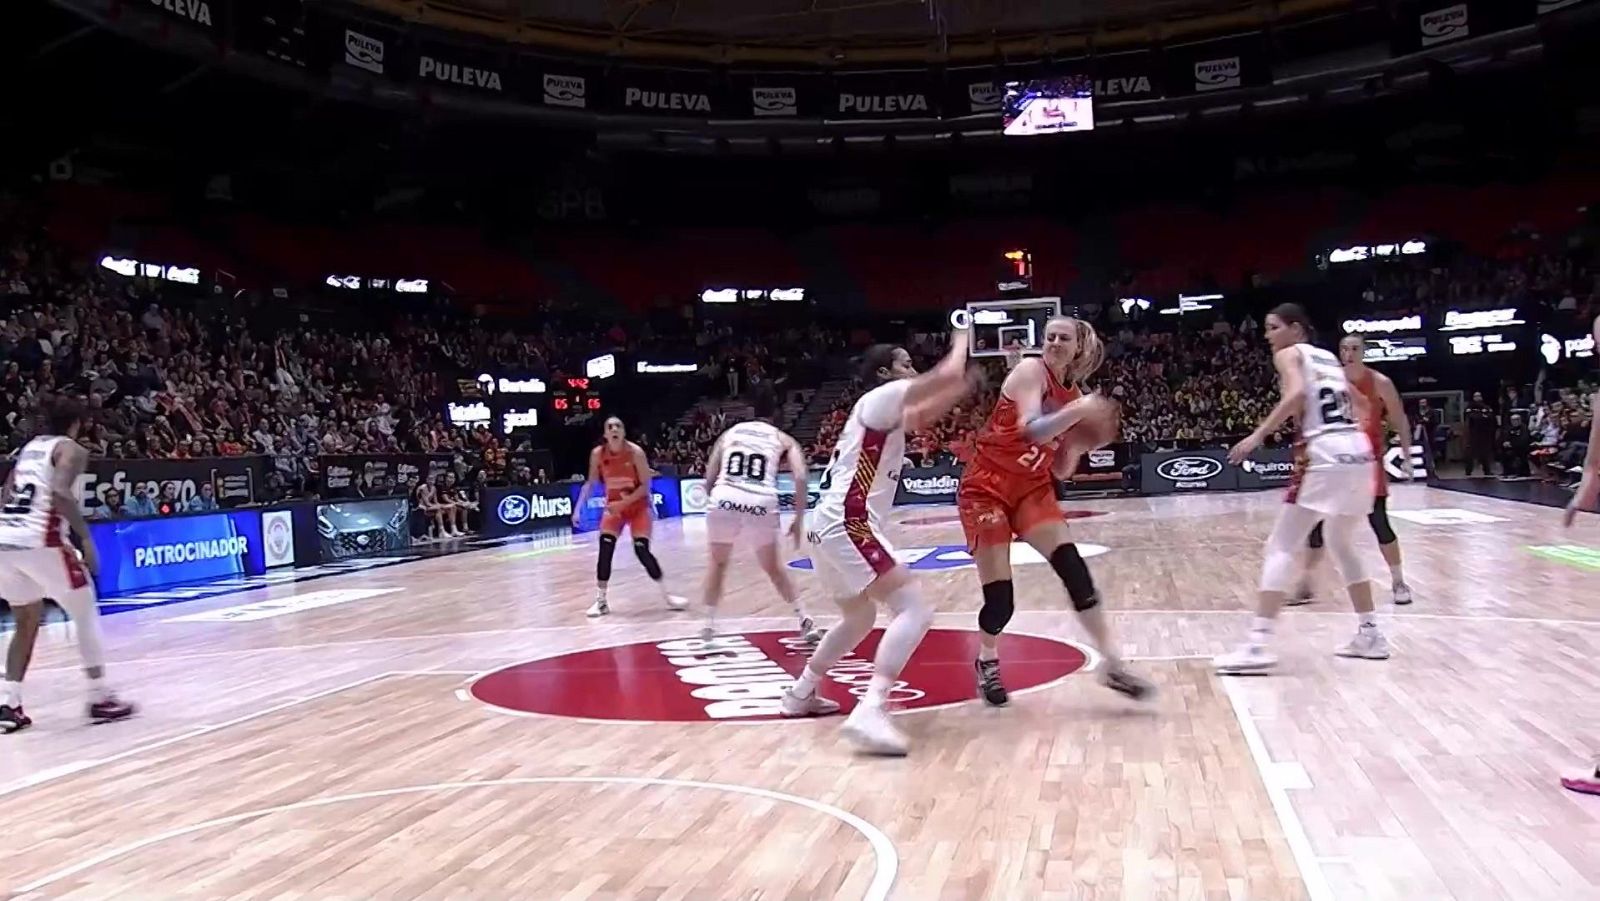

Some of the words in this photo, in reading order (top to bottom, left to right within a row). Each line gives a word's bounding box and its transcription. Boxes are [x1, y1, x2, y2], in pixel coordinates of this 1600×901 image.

[418, 56, 502, 91] PULEVA
[1094, 76, 1151, 96] LEVA
[625, 87, 711, 111] PULEVA
[839, 93, 928, 113] PULEVA
[727, 451, 767, 482] 00
[1016, 445, 1046, 472] 21
[531, 494, 572, 519] Atursa
[135, 535, 248, 568] PATROCINADOR
